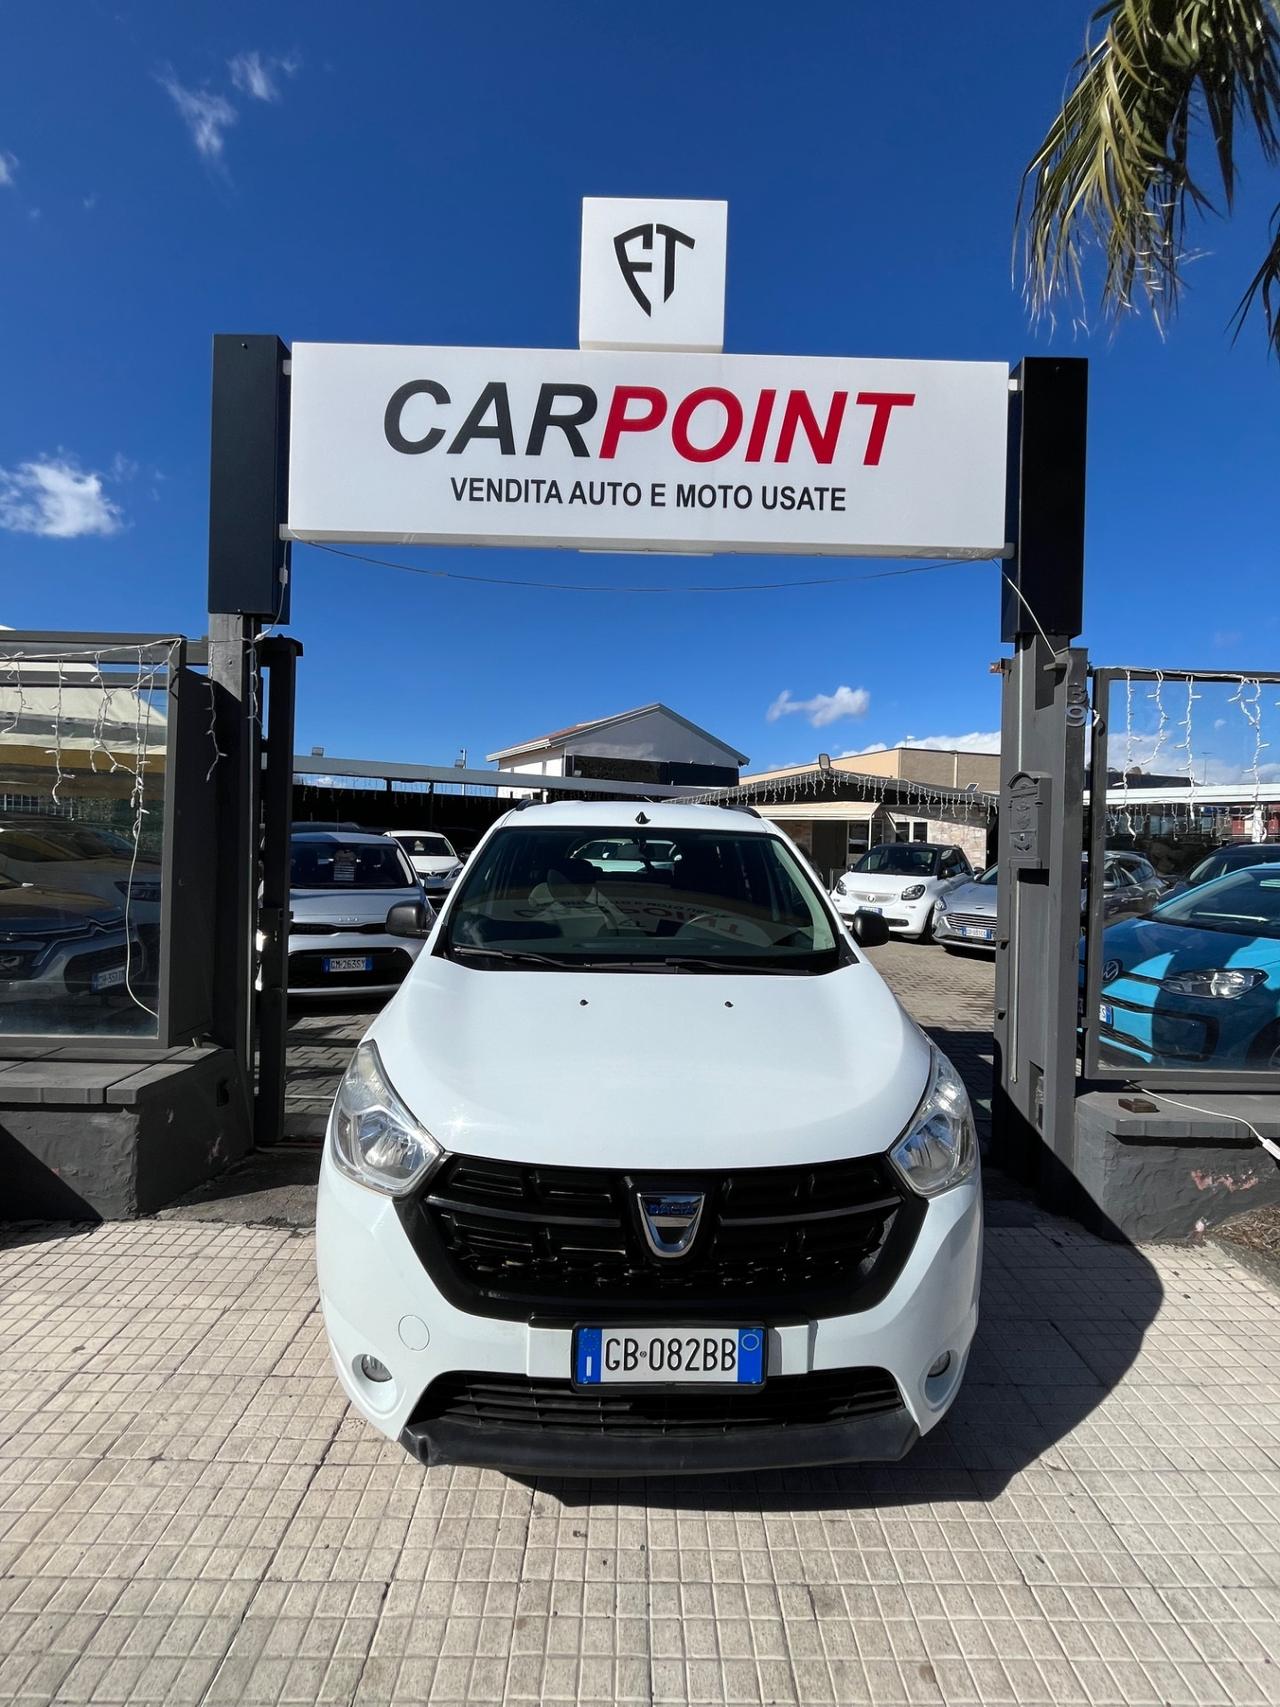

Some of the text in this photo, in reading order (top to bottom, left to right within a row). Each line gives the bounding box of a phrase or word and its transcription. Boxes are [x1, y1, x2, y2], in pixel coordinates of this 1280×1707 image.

[384, 379, 916, 466] CARPOINT
[451, 477, 846, 512] VENDITA AUTO E MOTO USATE
